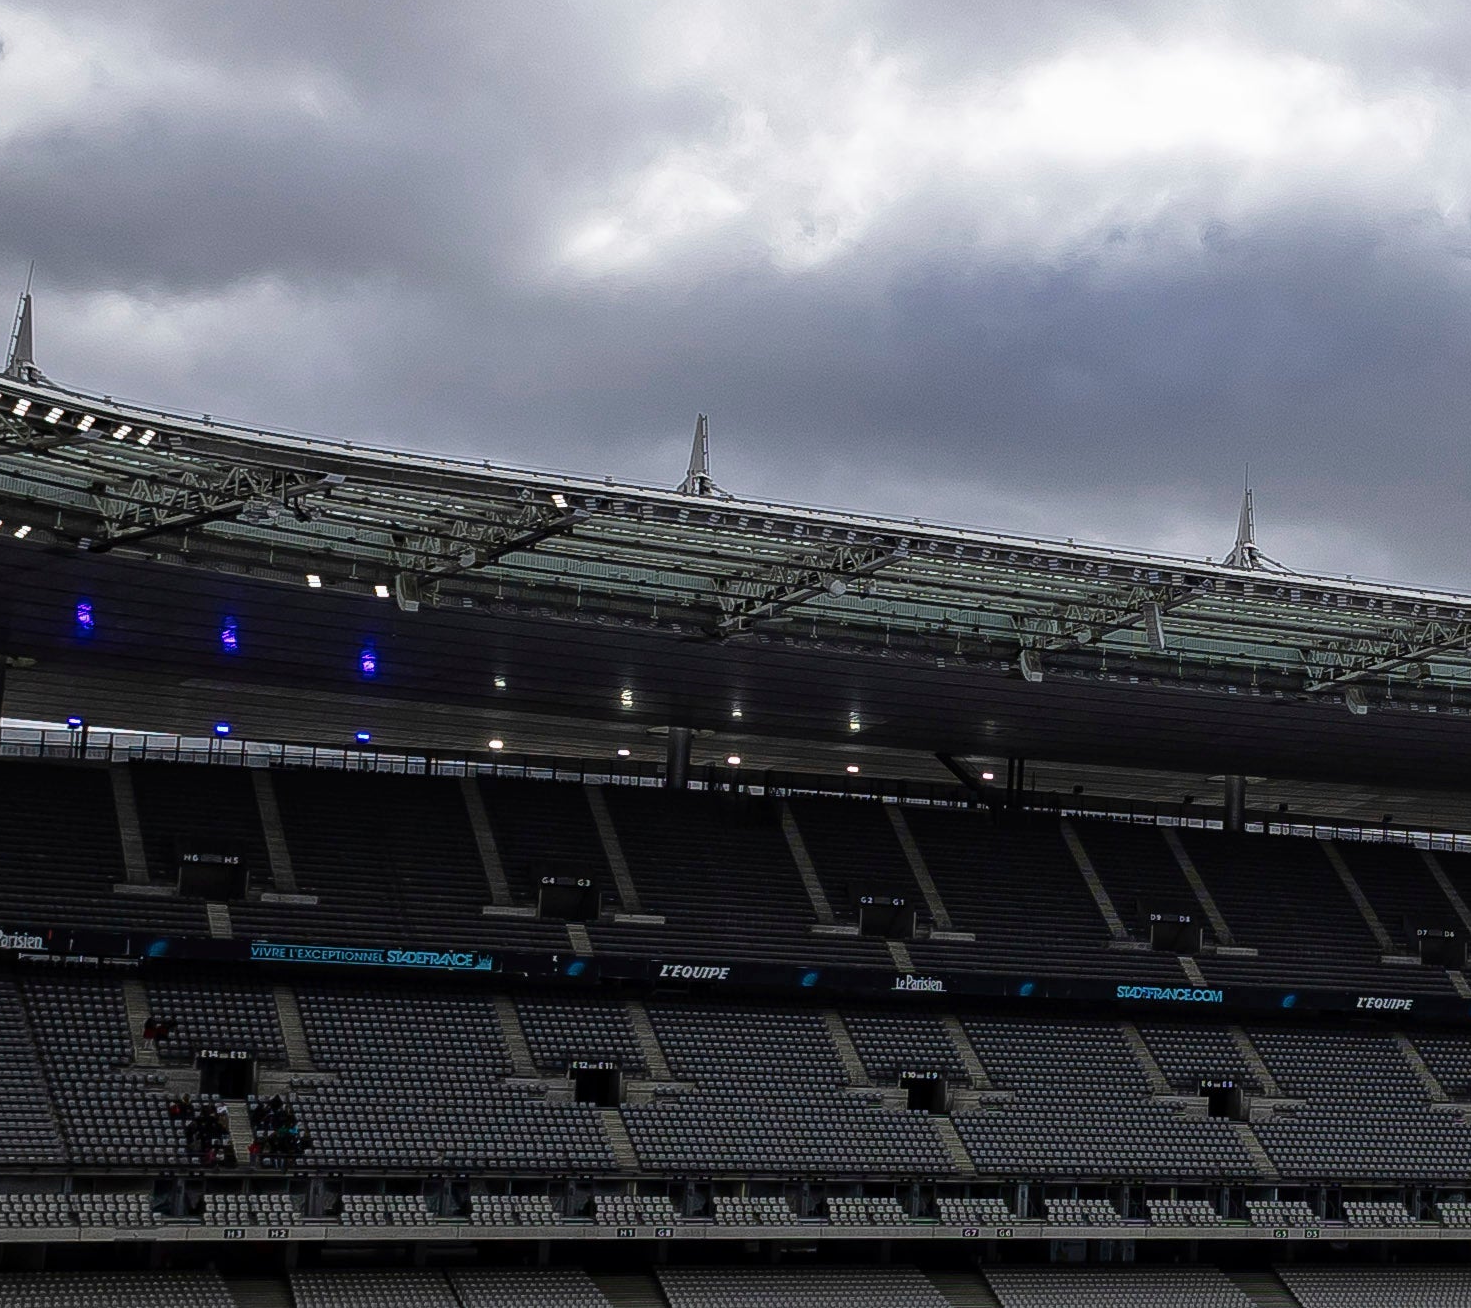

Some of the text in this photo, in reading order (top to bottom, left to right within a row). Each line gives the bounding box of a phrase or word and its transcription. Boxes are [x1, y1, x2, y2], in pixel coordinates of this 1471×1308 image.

[250, 946, 473, 967] VIVRE L'EXCEPTIONNEL STADEFRANCE
[895, 974, 942, 991] Le Parisien
